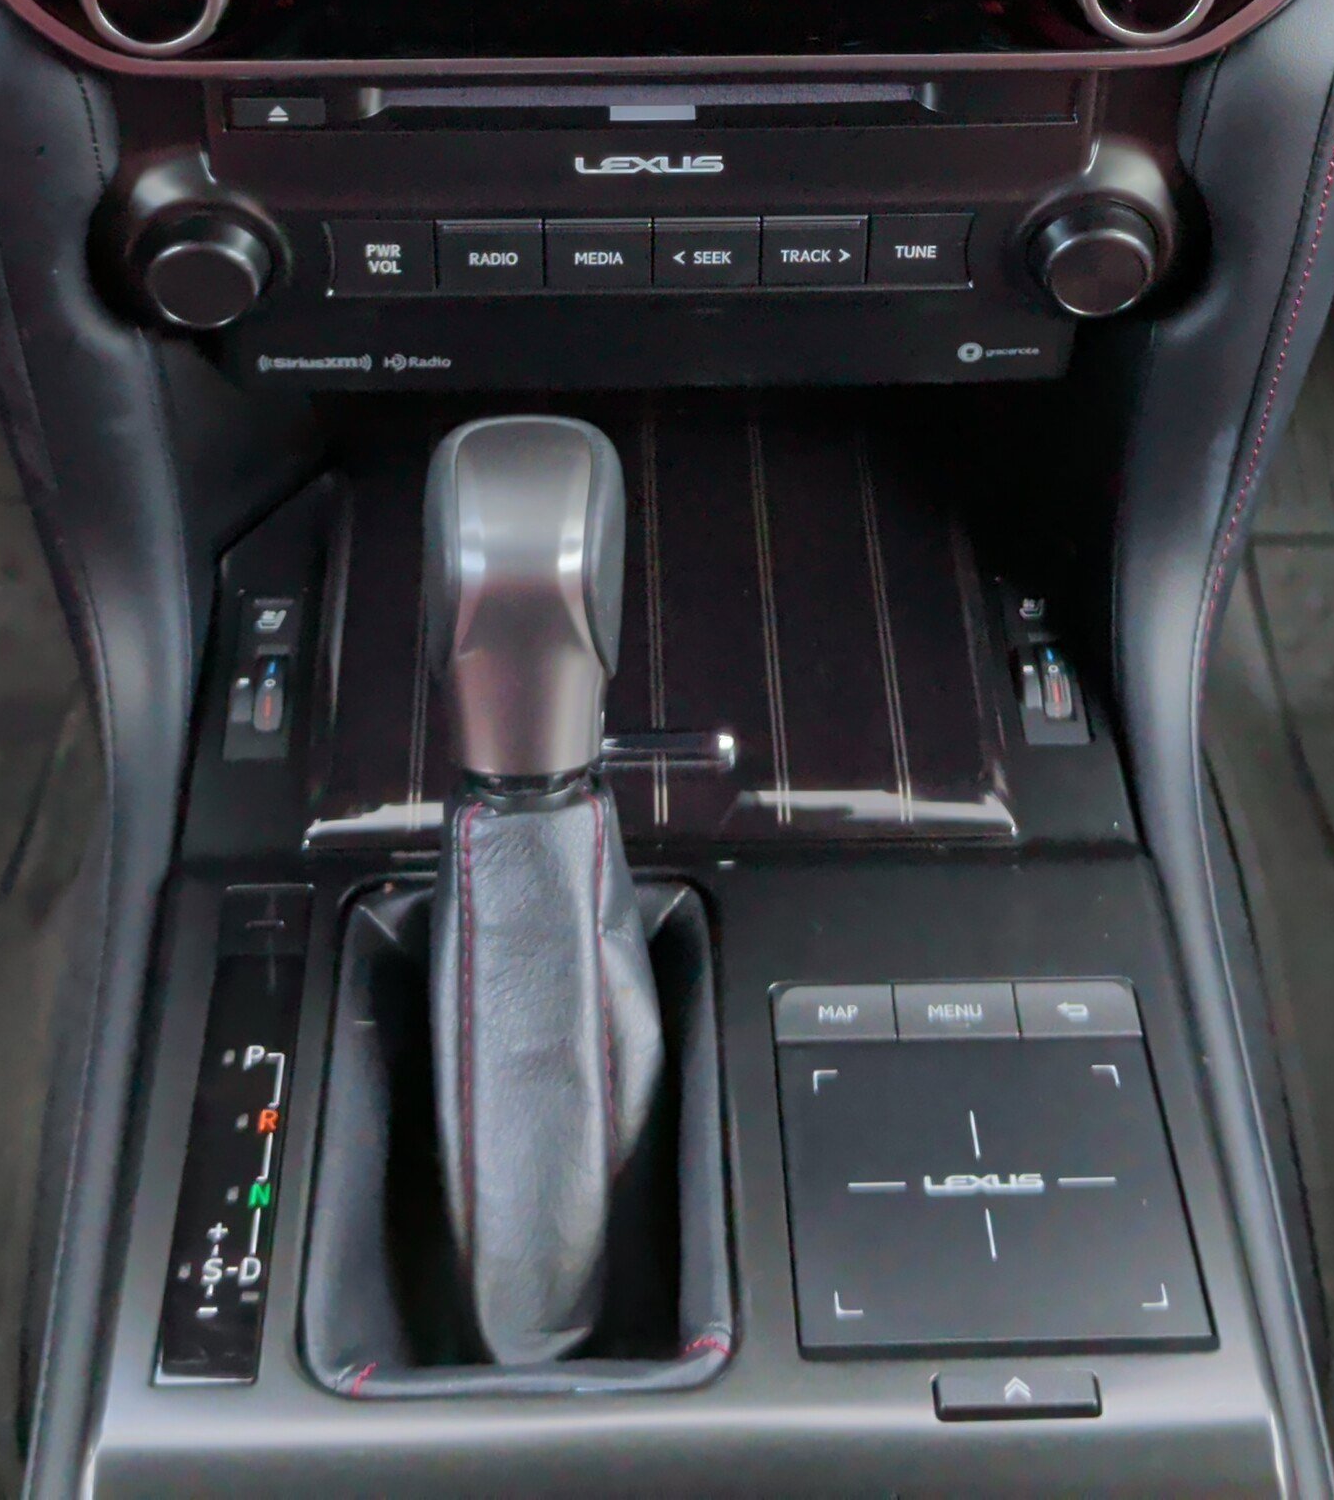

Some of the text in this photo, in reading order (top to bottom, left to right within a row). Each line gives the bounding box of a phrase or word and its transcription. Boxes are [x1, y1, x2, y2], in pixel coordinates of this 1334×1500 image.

[574, 155, 725, 174] LEXUS
[365, 243, 401, 258] PWR
[468, 251, 519, 266] RADIO
[574, 251, 624, 265] MEDIA
[894, 245, 937, 259] TUNE
[367, 259, 402, 274] VOL
[408, 355, 452, 368] Radio
[818, 1004, 859, 1021] MAP
[927, 1003, 983, 1020] MENU
[243, 1043, 266, 1069] P
[256, 1108, 280, 1133] R
[923, 1173, 1045, 1194] LEXUS
[248, 1182, 272, 1207] N
[200, 1256, 262, 1284] S D
